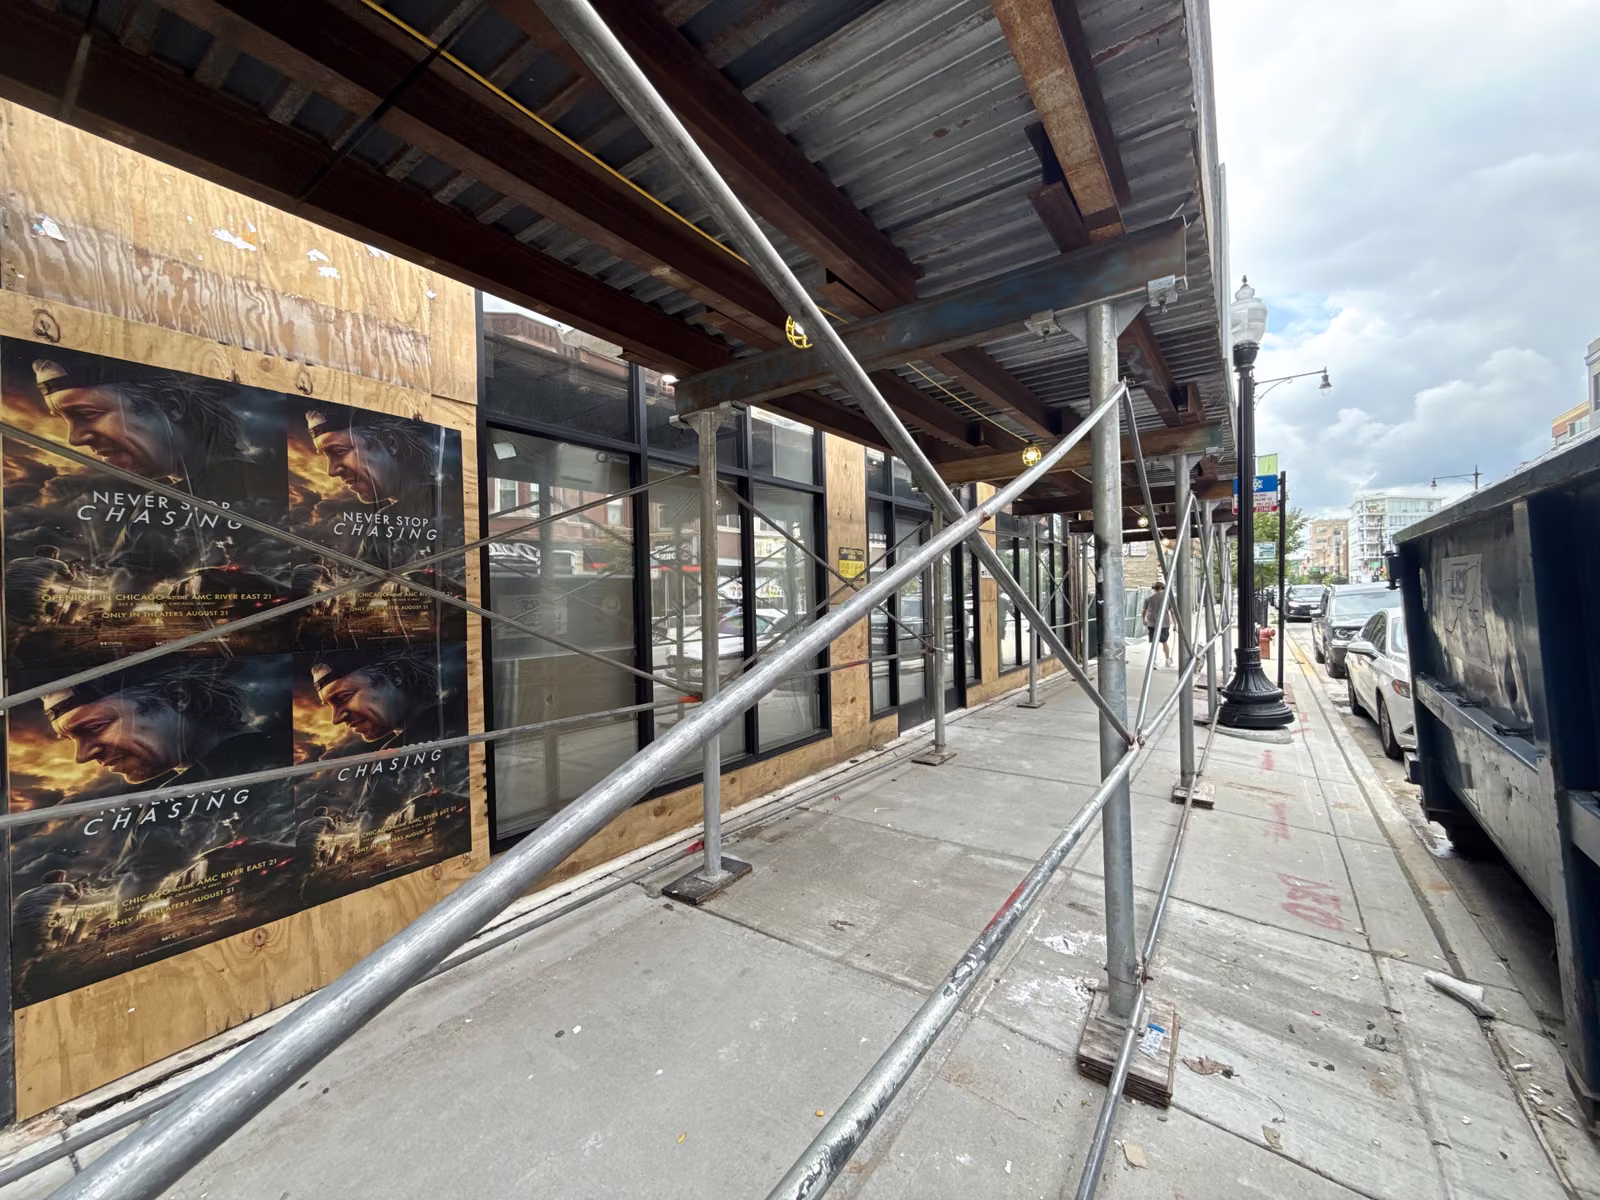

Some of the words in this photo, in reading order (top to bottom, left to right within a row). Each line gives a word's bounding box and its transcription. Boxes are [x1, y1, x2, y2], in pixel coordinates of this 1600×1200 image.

[93, 490, 169, 508] NEVER
[77, 505, 242, 530] CHASING
[333, 522, 438, 540] CHASING
[343, 511, 390, 524] NEVER
[396, 516, 429, 528] STOP
[338, 750, 442, 782] CHASING
[83, 790, 249, 836] CHASING
[122, 888, 170, 907] CHICAGO
[197, 874, 218, 886] AMC
[220, 868, 244, 879] RIVER
[246, 861, 266, 872] EAST
[108, 916, 133, 929] ONLY
[192, 889, 224, 904] AUGUST
